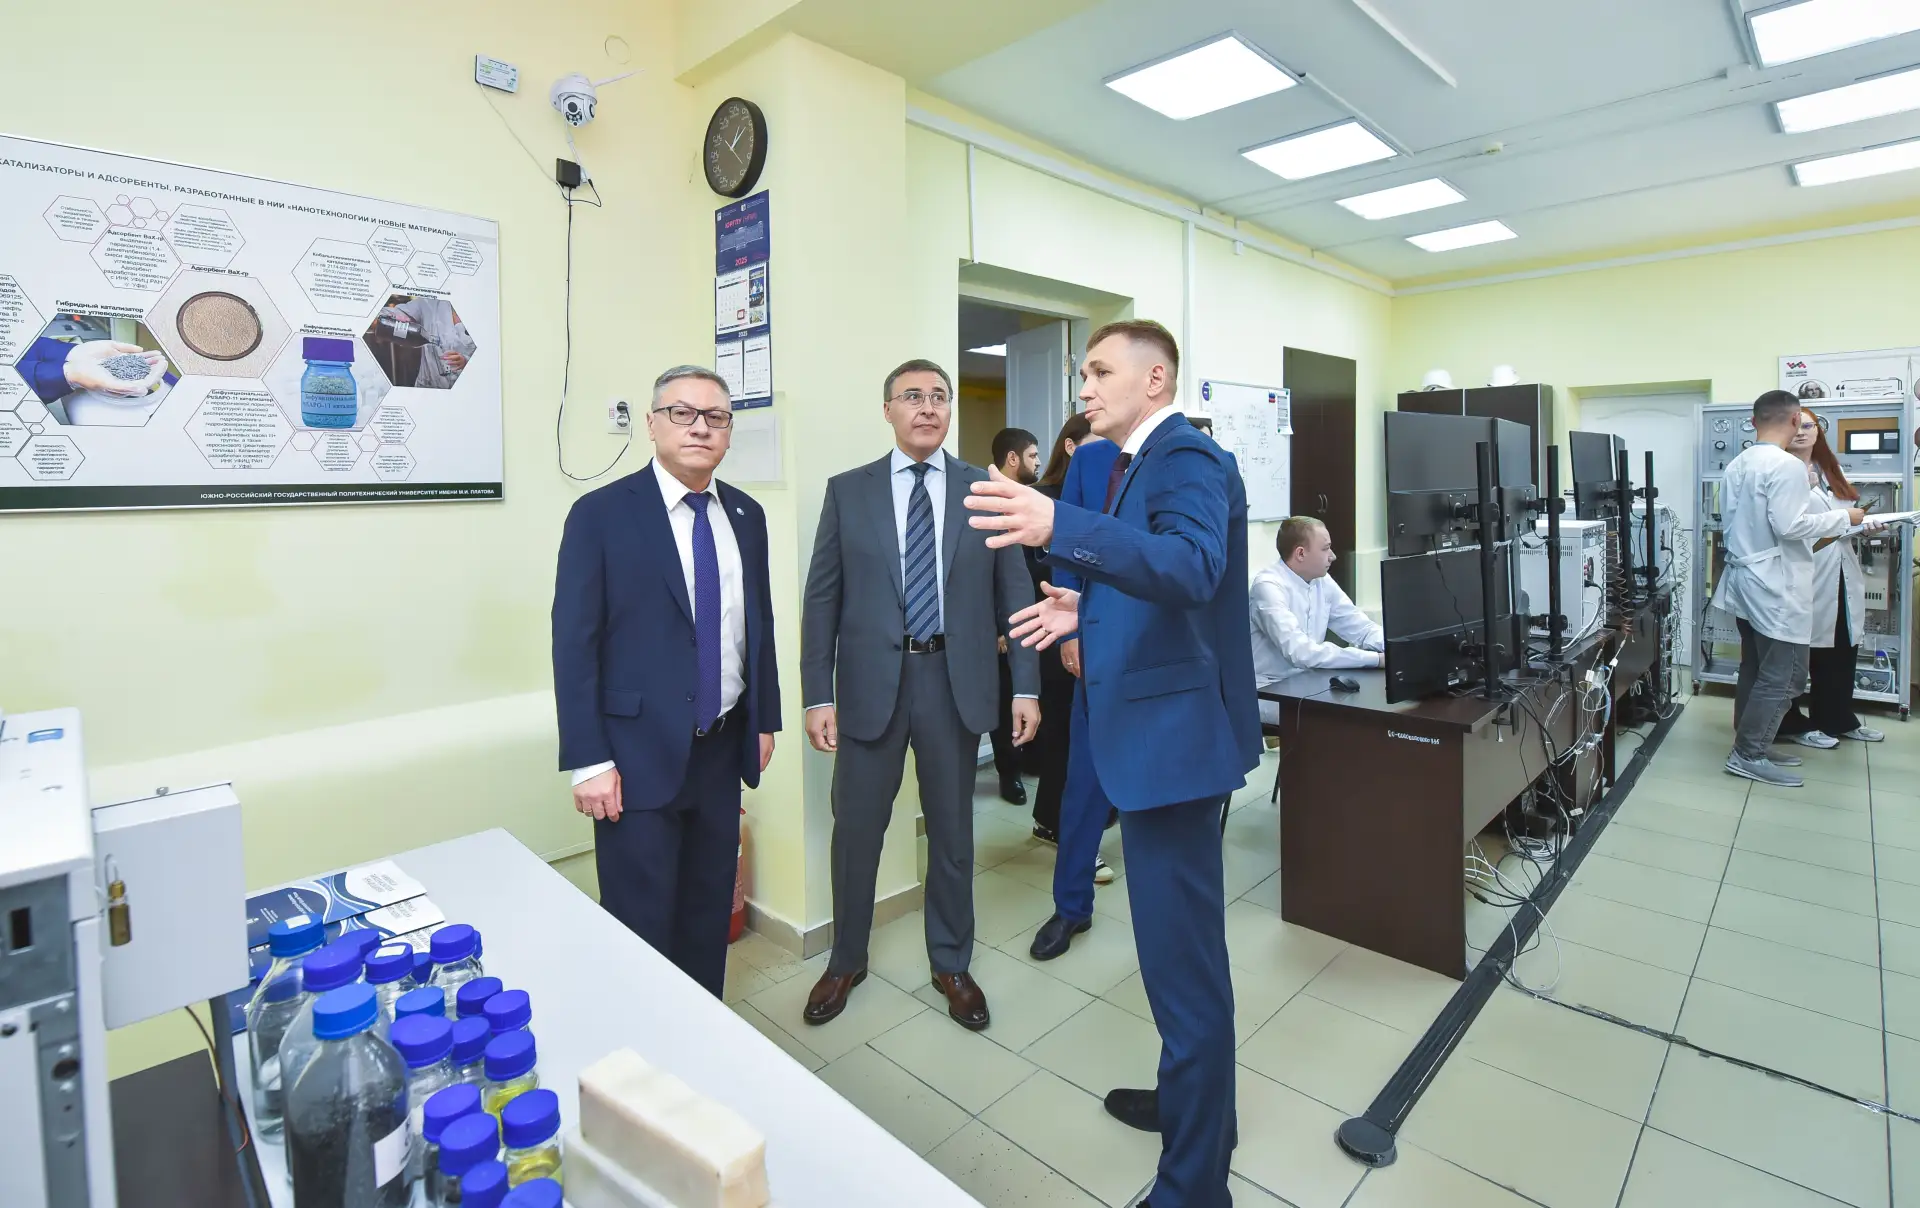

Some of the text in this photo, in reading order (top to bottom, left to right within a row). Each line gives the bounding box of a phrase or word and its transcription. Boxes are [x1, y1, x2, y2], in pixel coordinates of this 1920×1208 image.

[87, 171, 95, 179] И
[98, 173, 172, 192] АДСОРБЕНТЫ,
[174, 184, 256, 204] РАЗРАБОТАННЫЕ
[258, 198, 265, 206] В
[266, 200, 285, 209] НИИ
[287, 203, 369, 223] «НАНОТЕХНОЛОГИИ
[378, 217, 407, 229] НОВЫЕ
[408, 223, 458, 238] МАТЕРИАЛЫ»
[107, 229, 142, 238] Адсорбент
[735, 256, 748, 267] 2025
[190, 265, 226, 273] Адсорбент
[55, 299, 144, 314] Гибридный катализатор
[56, 307, 143, 319] синтеза углеводородов
[200, 491, 273, 499] ЮЖНО-РОССИЙСКИЙ
[273, 490, 337, 498] ГОСУДАРСТВЕННЫЙ
